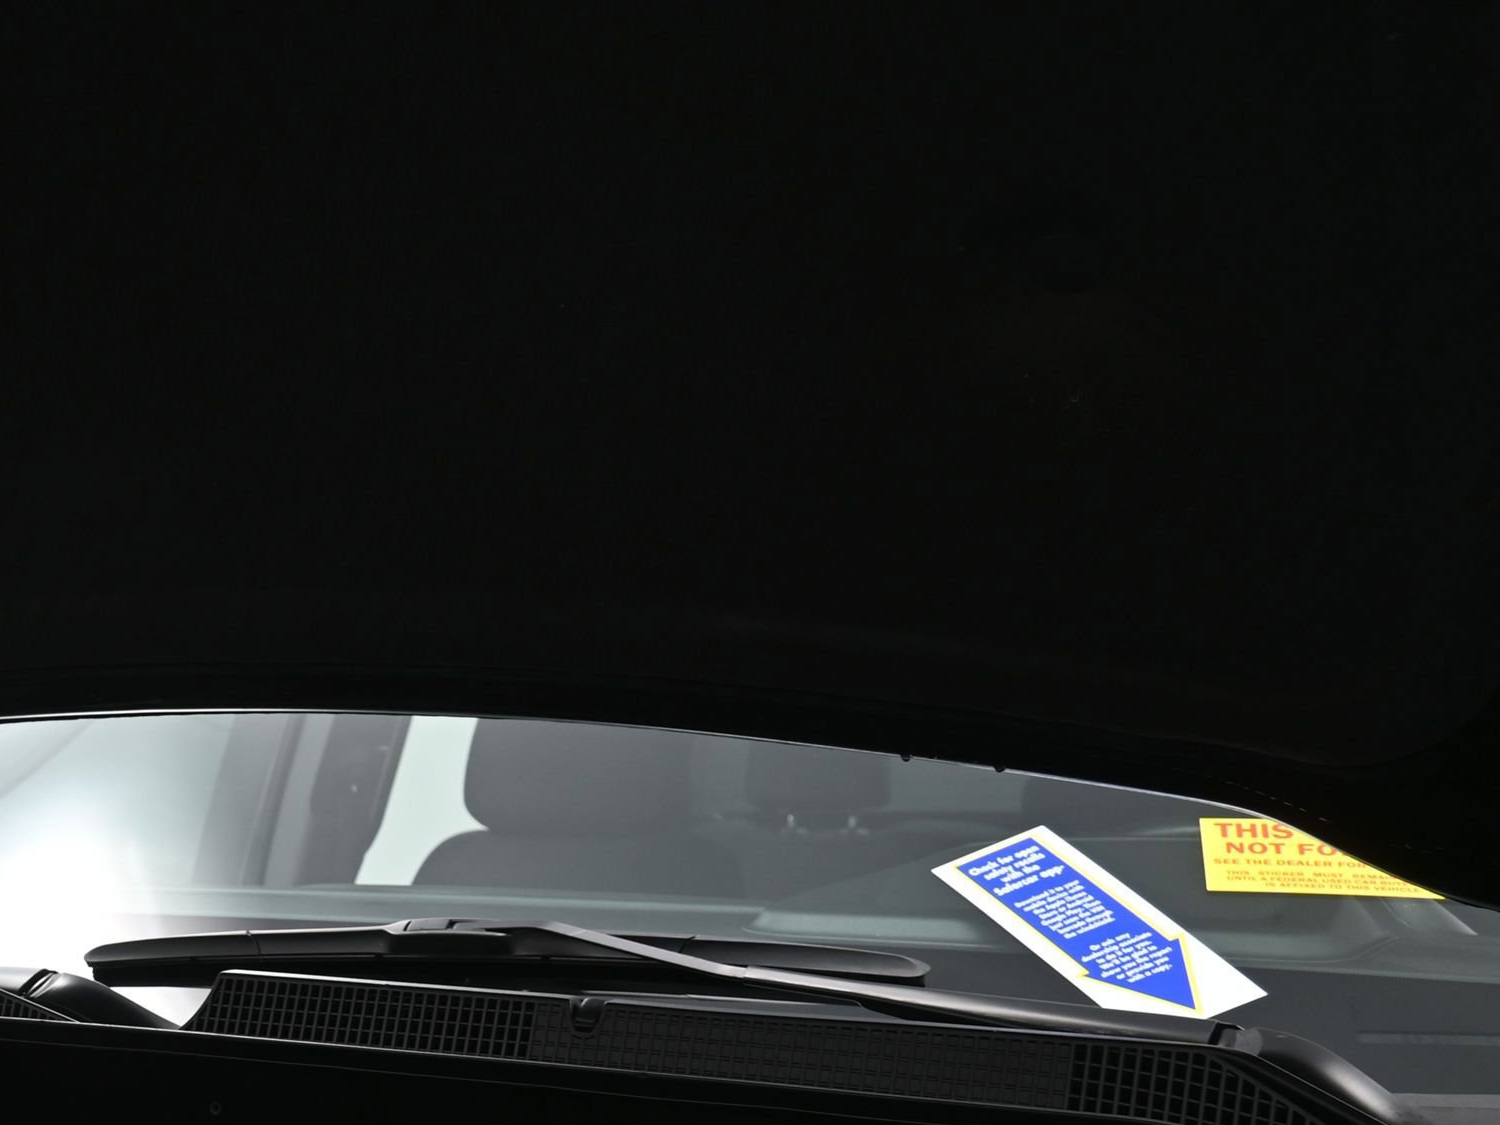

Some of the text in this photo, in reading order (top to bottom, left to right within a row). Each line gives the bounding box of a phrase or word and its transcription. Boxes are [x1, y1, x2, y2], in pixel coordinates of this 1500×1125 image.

[1213, 823, 1294, 839] THIS
[1225, 841, 1285, 854] NOT
[997, 855, 1014, 865] for
[1014, 846, 1039, 858] open
[1022, 864, 1040, 874] the
[1246, 858, 1272, 866] THE
[1276, 859, 1332, 867] DEALER
